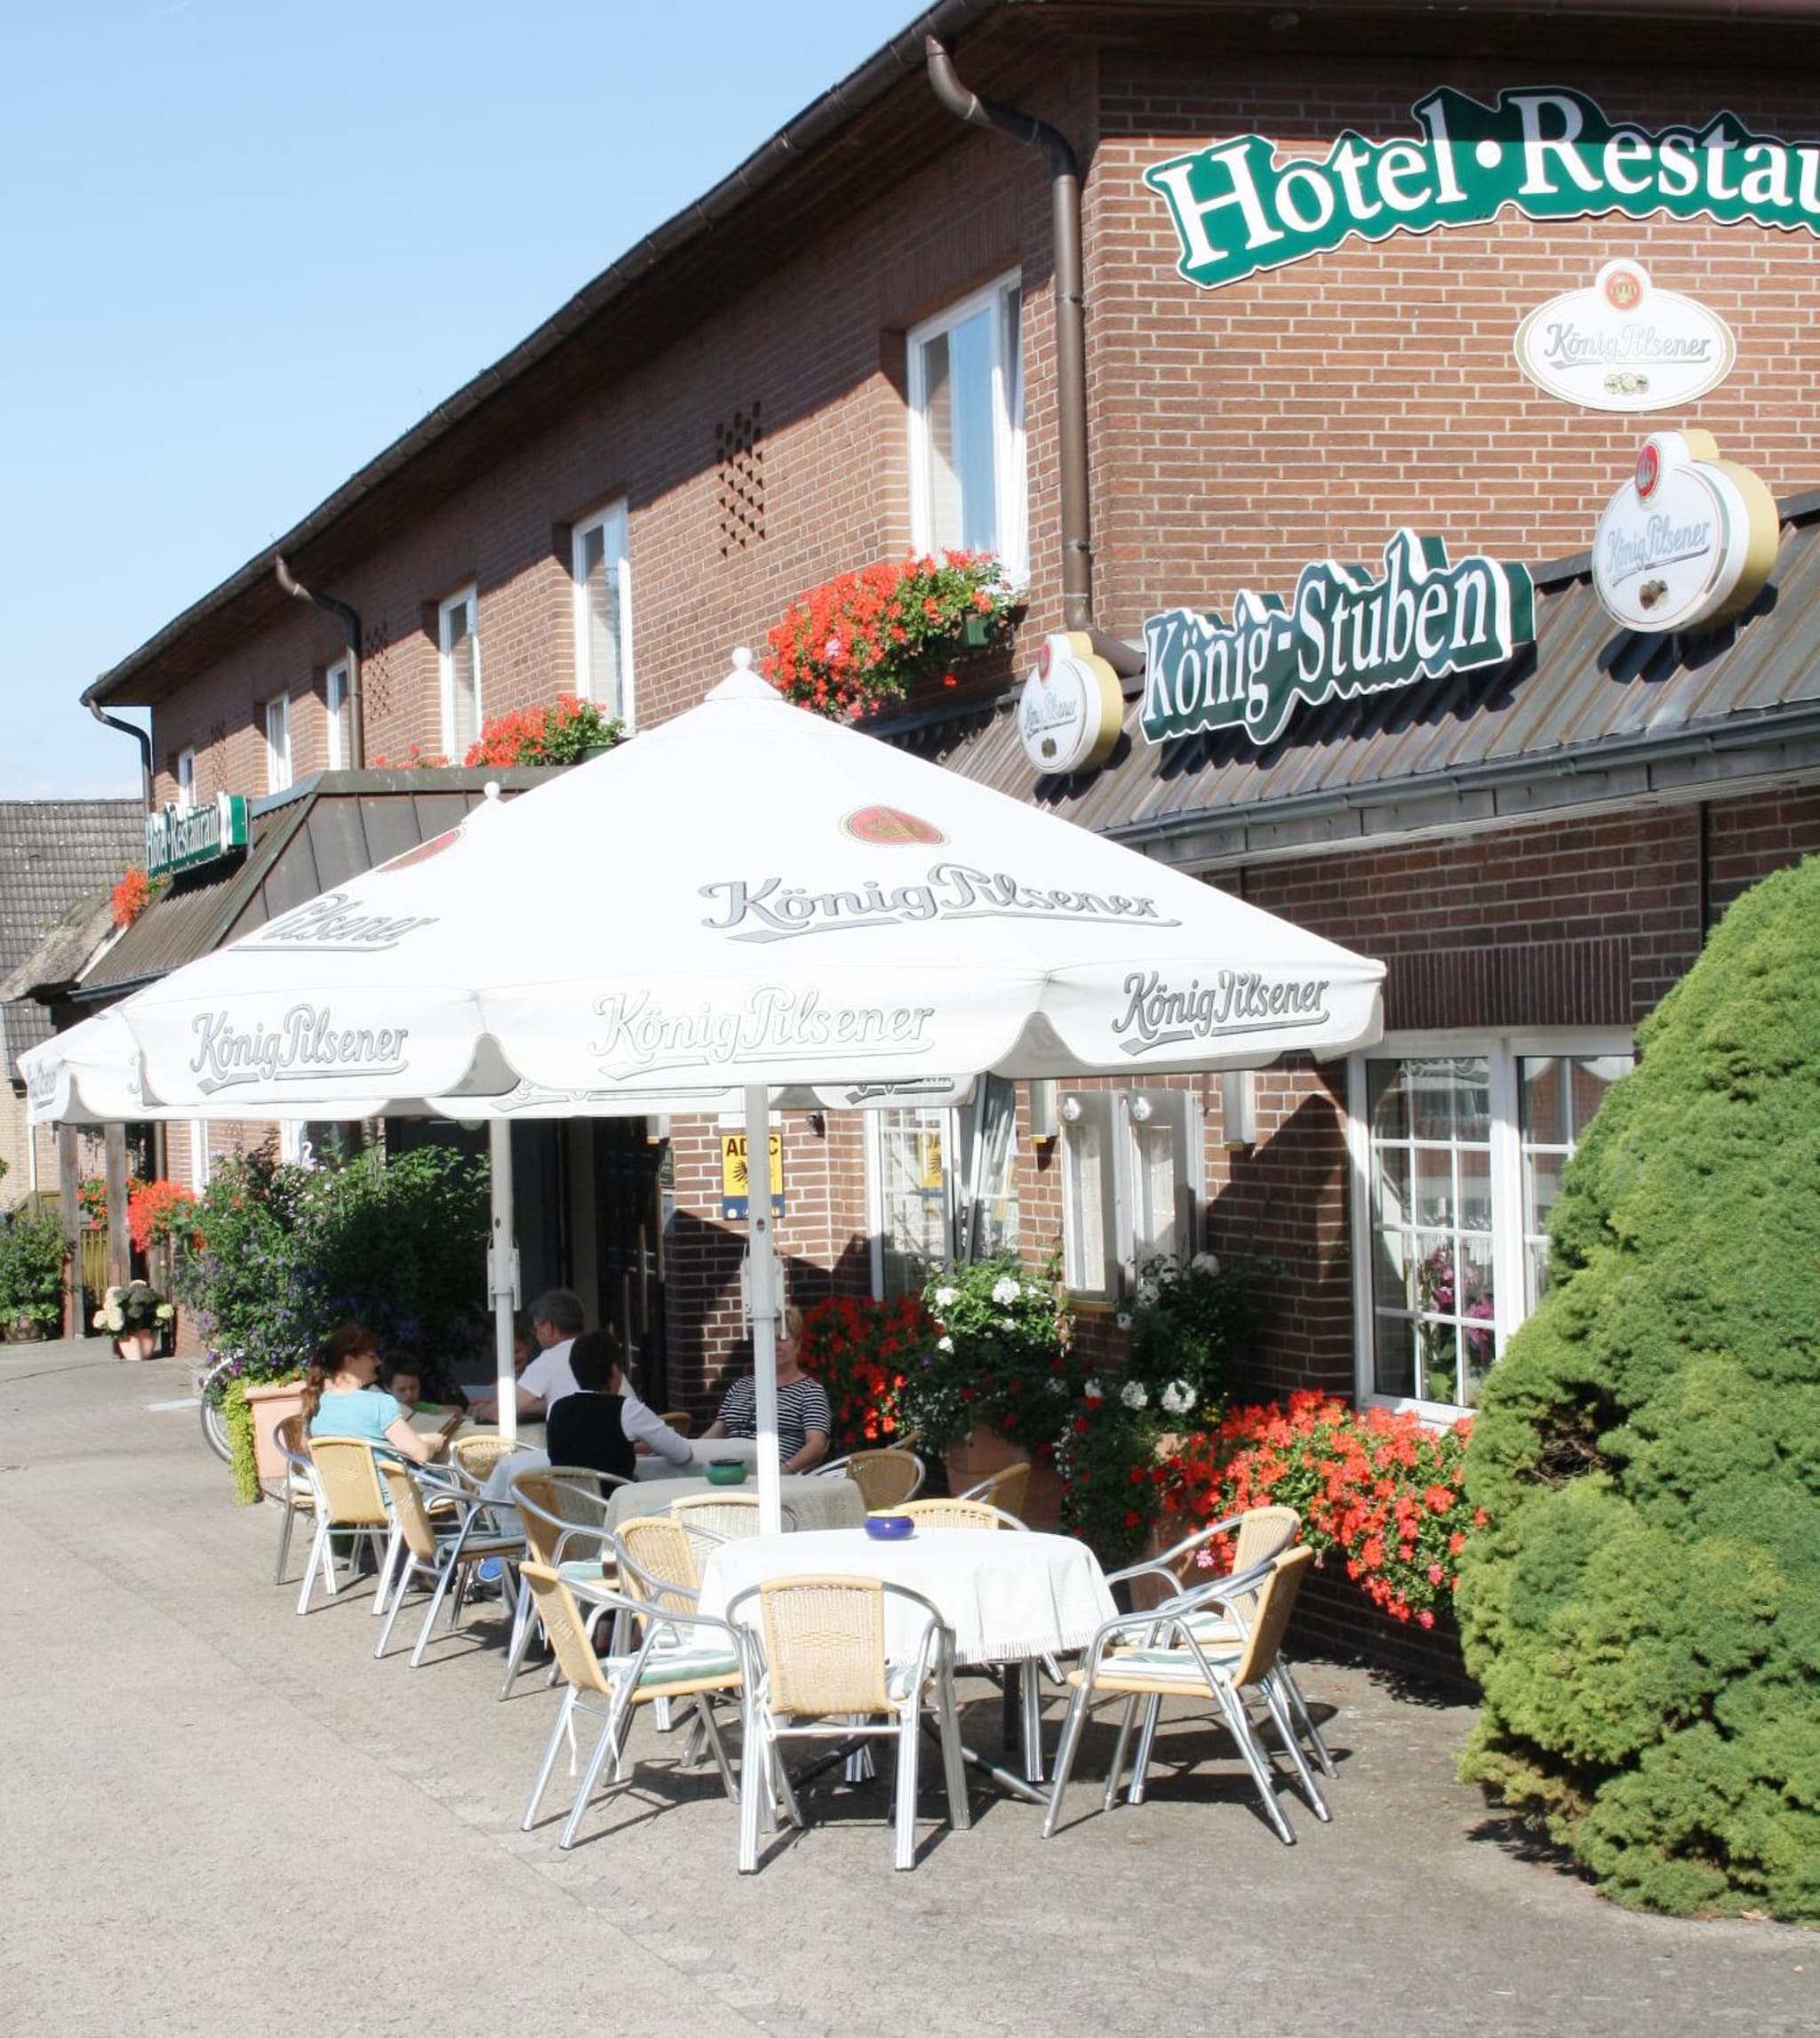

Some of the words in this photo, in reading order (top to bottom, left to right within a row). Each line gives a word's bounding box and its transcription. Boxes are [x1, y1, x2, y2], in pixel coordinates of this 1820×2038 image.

[1153, 98, 1467, 269] Hotel
[1544, 323, 1618, 363] König
[1618, 324, 1712, 357] Pilsener
[1646, 514, 1711, 557] Pilsener
[1143, 540, 1488, 723] König-Stuben
[698, 876, 938, 931] König
[928, 862, 1160, 918] Pilsener
[588, 988, 740, 1065] König
[738, 983, 935, 1050] Pilsener
[1112, 971, 1217, 1040] König
[1213, 970, 1329, 1023] Pilsener
[189, 1010, 282, 1080] König
[277, 1003, 409, 1067] Pilsener
[726, 1137, 778, 1157] ADC
